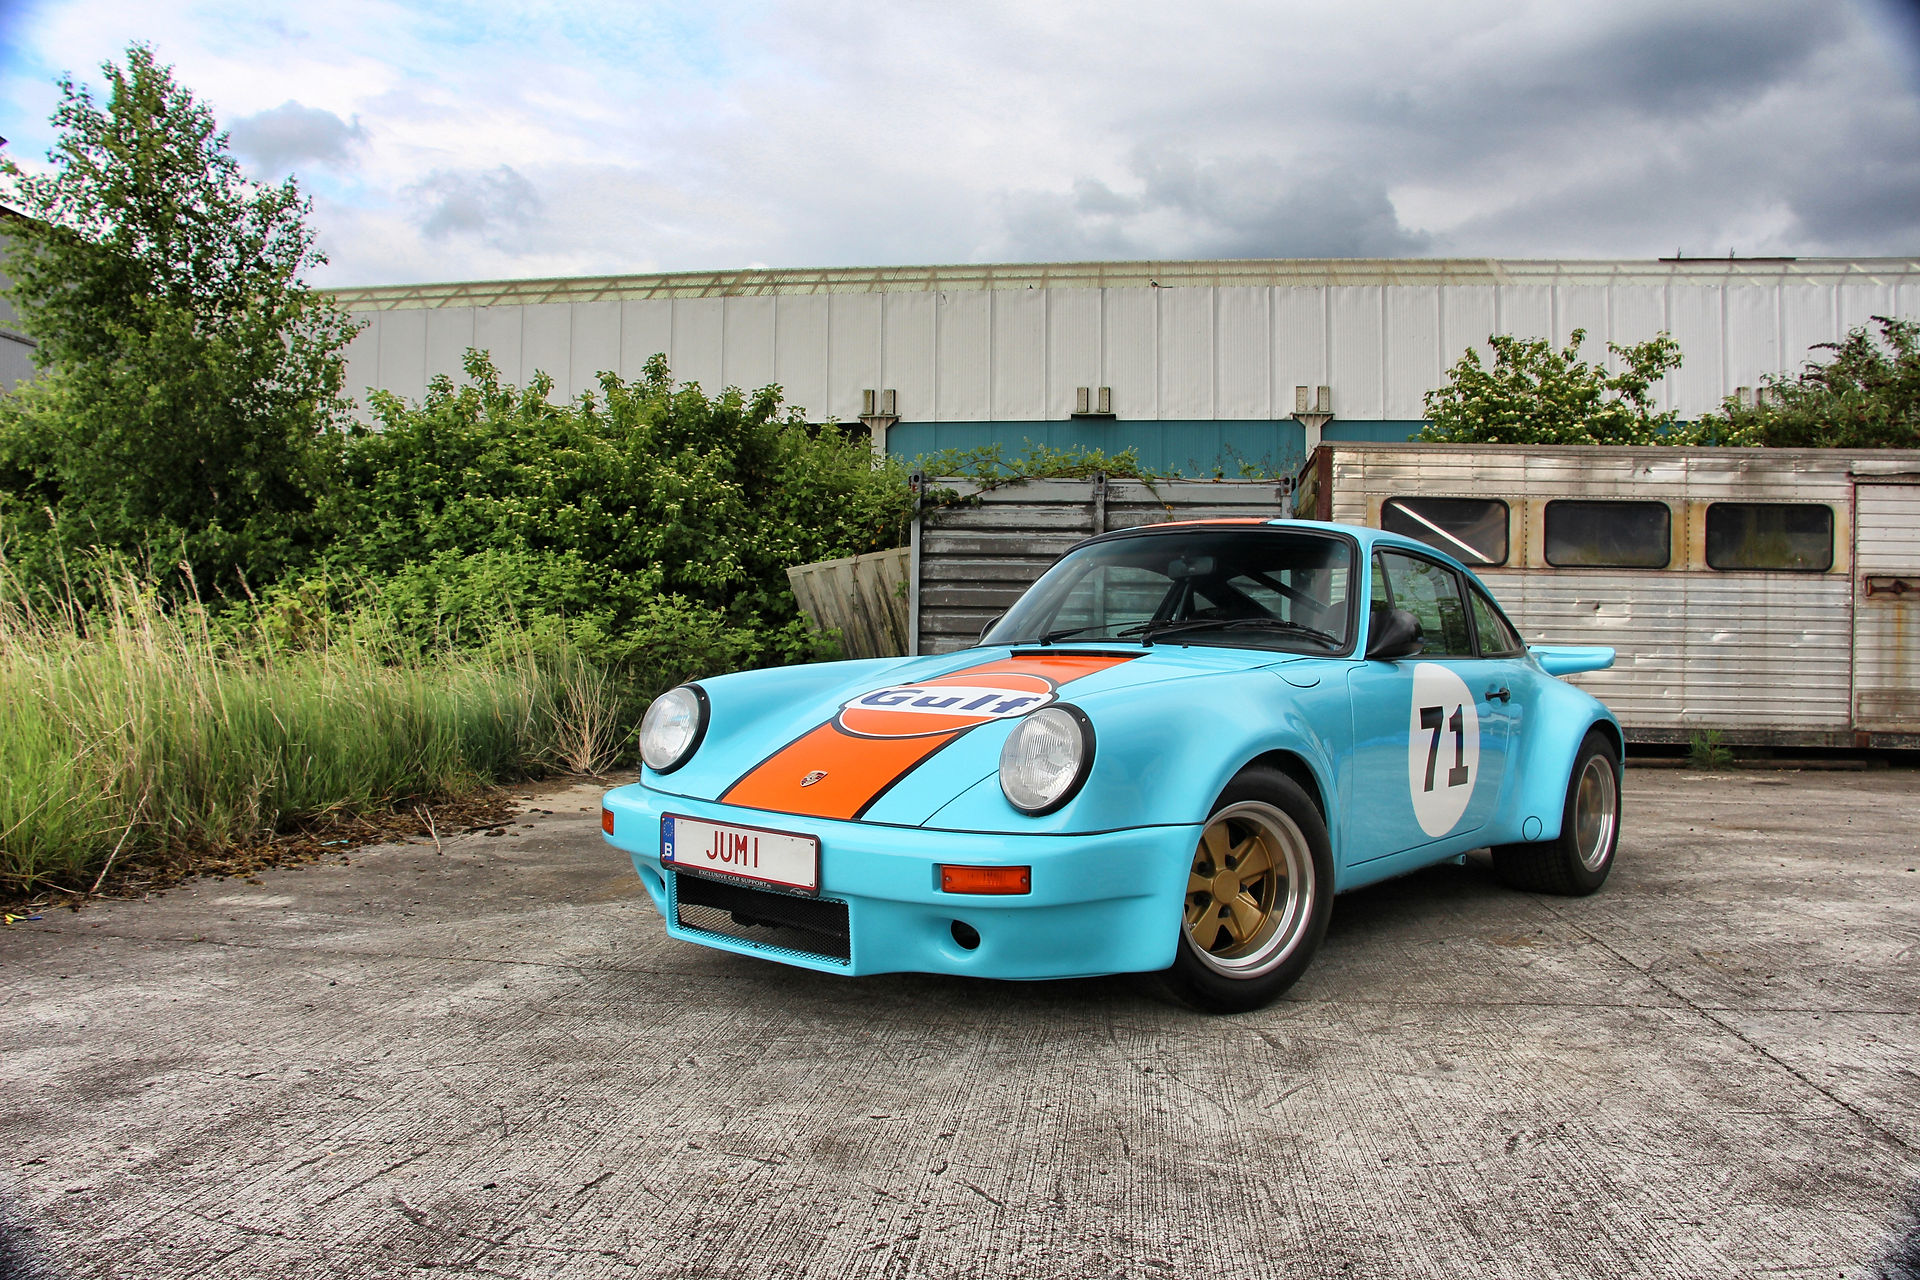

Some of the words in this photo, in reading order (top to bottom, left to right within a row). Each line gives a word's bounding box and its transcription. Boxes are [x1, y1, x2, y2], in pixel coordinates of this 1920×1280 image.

[861, 689, 1041, 714] Gulf
[1420, 704, 1469, 792] 71
[664, 842, 672, 857] B
[698, 869, 727, 880] EXCLUSIVE
[740, 877, 767, 887] SUPPORT
